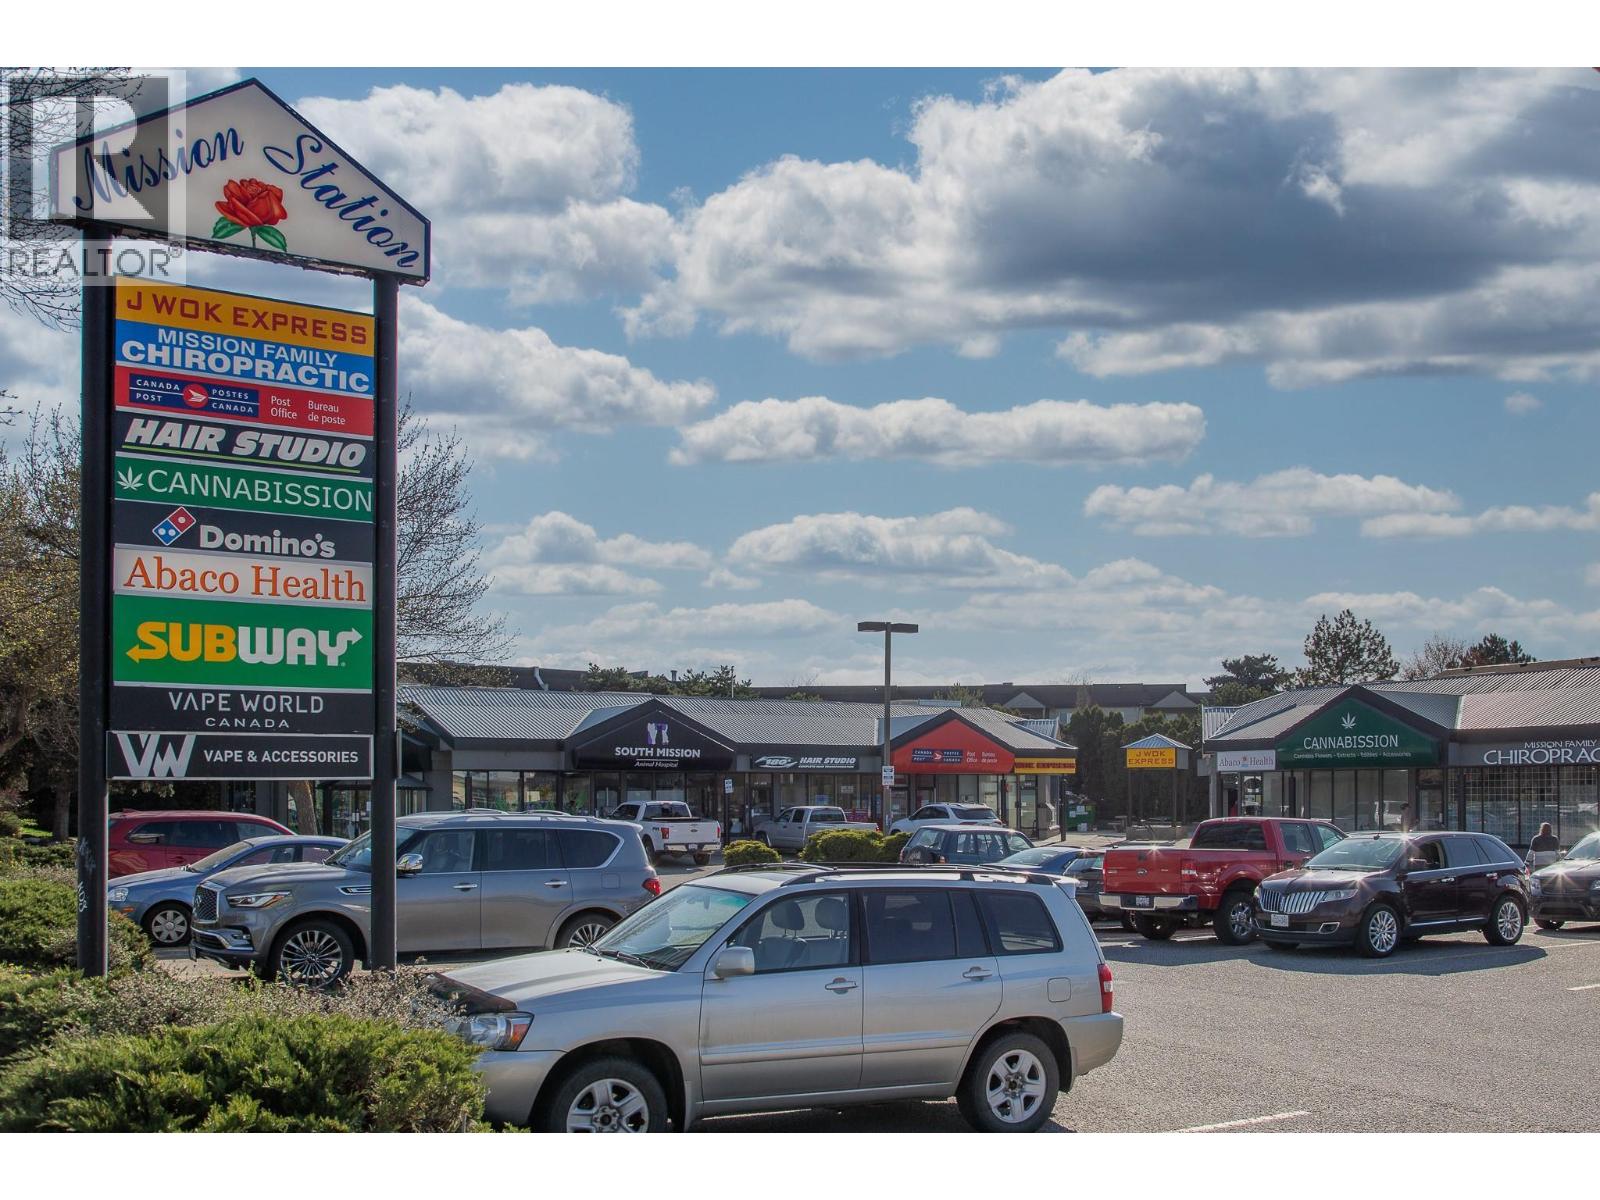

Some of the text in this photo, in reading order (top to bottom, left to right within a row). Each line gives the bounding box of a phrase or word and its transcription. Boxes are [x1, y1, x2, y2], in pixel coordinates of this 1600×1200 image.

[72, 127, 420, 268] Mission Station
[127, 291, 367, 345] J WOK EXPRESS
[157, 328, 338, 368] MISSION FAMILY
[121, 340, 369, 392] CHIROPRACTIC
[136, 379, 249, 400] CANADA POSTES
[136, 392, 254, 414] POST CANADA
[270, 395, 339, 413] Post Bureau
[270, 407, 346, 425] Office de poste
[124, 418, 366, 467] HAIR STUDIO
[148, 469, 372, 512] CANNABISSION
[200, 524, 336, 558] Domino's
[123, 556, 366, 602] Abaco Health
[126, 621, 363, 667] SUBWAY
[168, 691, 324, 714] VAPE WORLD
[205, 717, 290, 728] CANADA
[615, 747, 701, 758] SOUTH MISSION
[1303, 734, 1399, 750] CANNABISSION
[1524, 739, 1597, 749] MISSION FAMILY
[203, 750, 359, 763] VAPE & ACCESSORIES
